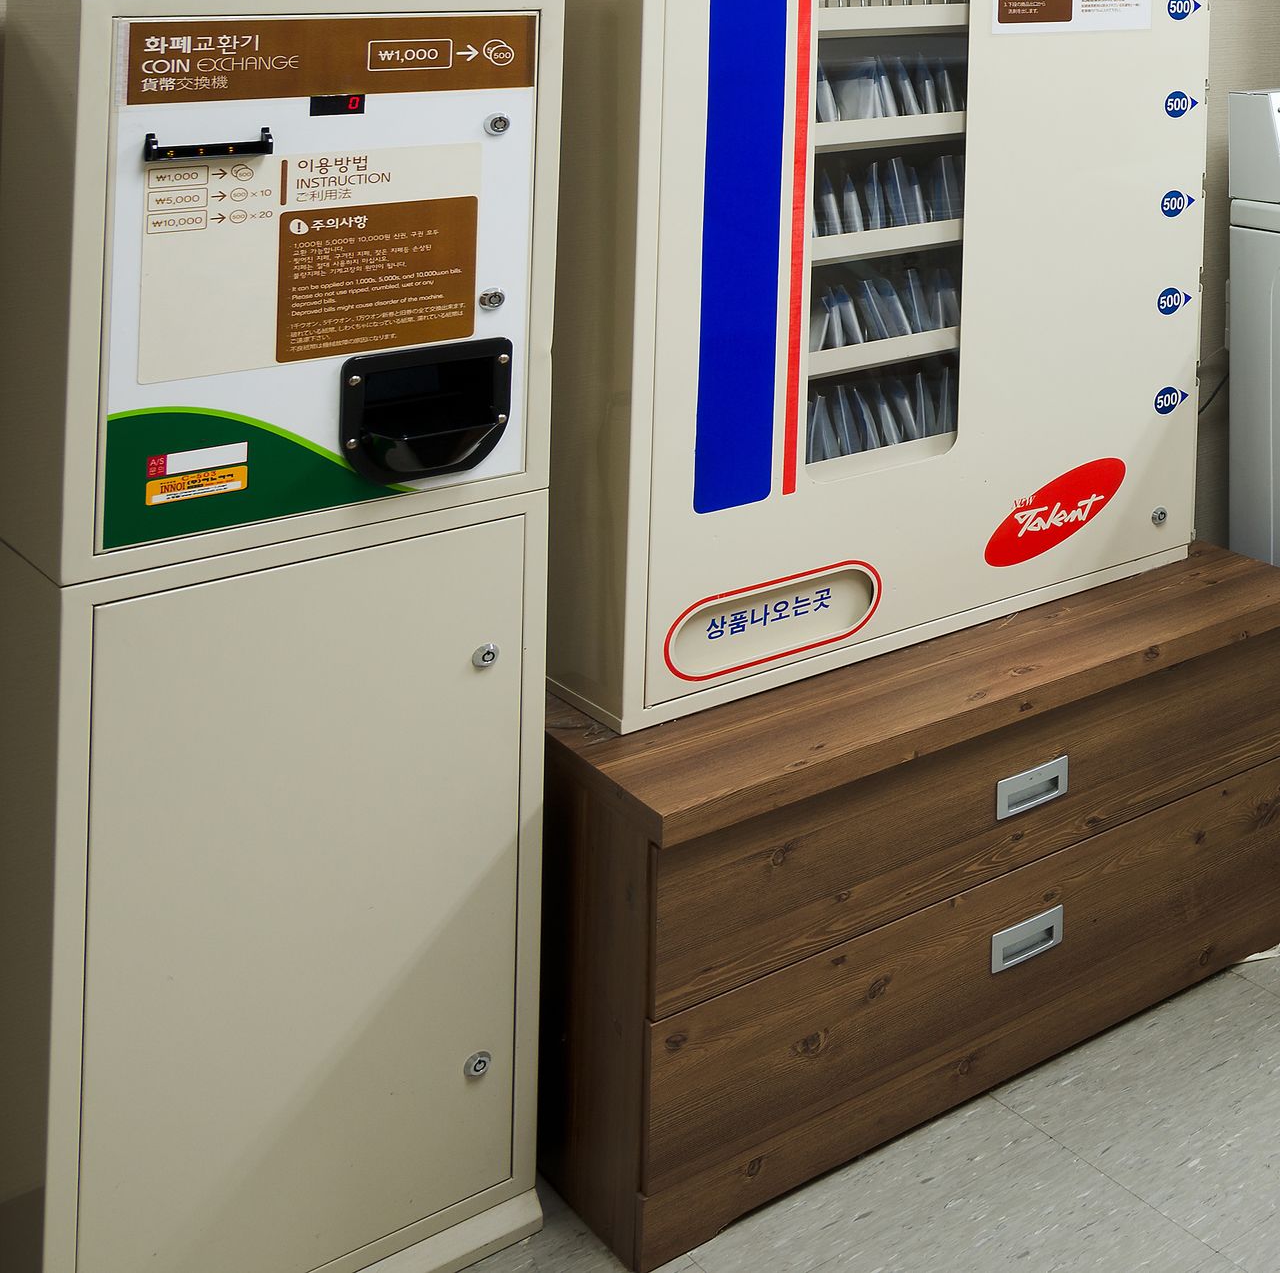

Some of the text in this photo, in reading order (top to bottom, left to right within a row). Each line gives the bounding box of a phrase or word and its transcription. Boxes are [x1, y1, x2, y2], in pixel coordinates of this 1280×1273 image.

[1170, 0, 1190, 14] 500
[144, 34, 260, 55] 화폐교환기
[378, 48, 439, 63] ₩1,000
[142, 55, 300, 74] COIN EXCHANGE
[141, 75, 229, 93] 貨幣交換機
[348, 96, 360, 110] 0
[1167, 97, 1187, 111] 500
[298, 156, 368, 175] 이용방법
[156, 172, 199, 183] ₩1,000
[296, 172, 391, 189] INSTRUCTION
[155, 195, 200, 205] ₩5,000
[260, 189, 272, 197] 10
[296, 189, 352, 203] ご利用法
[1163, 196, 1183, 211] 500
[152, 217, 203, 227] ₩10,000
[259, 211, 273, 219] 20
[311, 215, 369, 232] 주의사항
[320, 281, 345, 290] applied
[337, 304, 355, 312] might
[374, 298, 399, 306] disorder
[1160, 293, 1180, 307] 500
[1156, 393, 1178, 407] 500
[149, 457, 165, 466] A/S
[1012, 495, 1036, 508] NEW
[1014, 493, 1105, 538] Talent
[706, 588, 832, 640] 상품나오는곳
